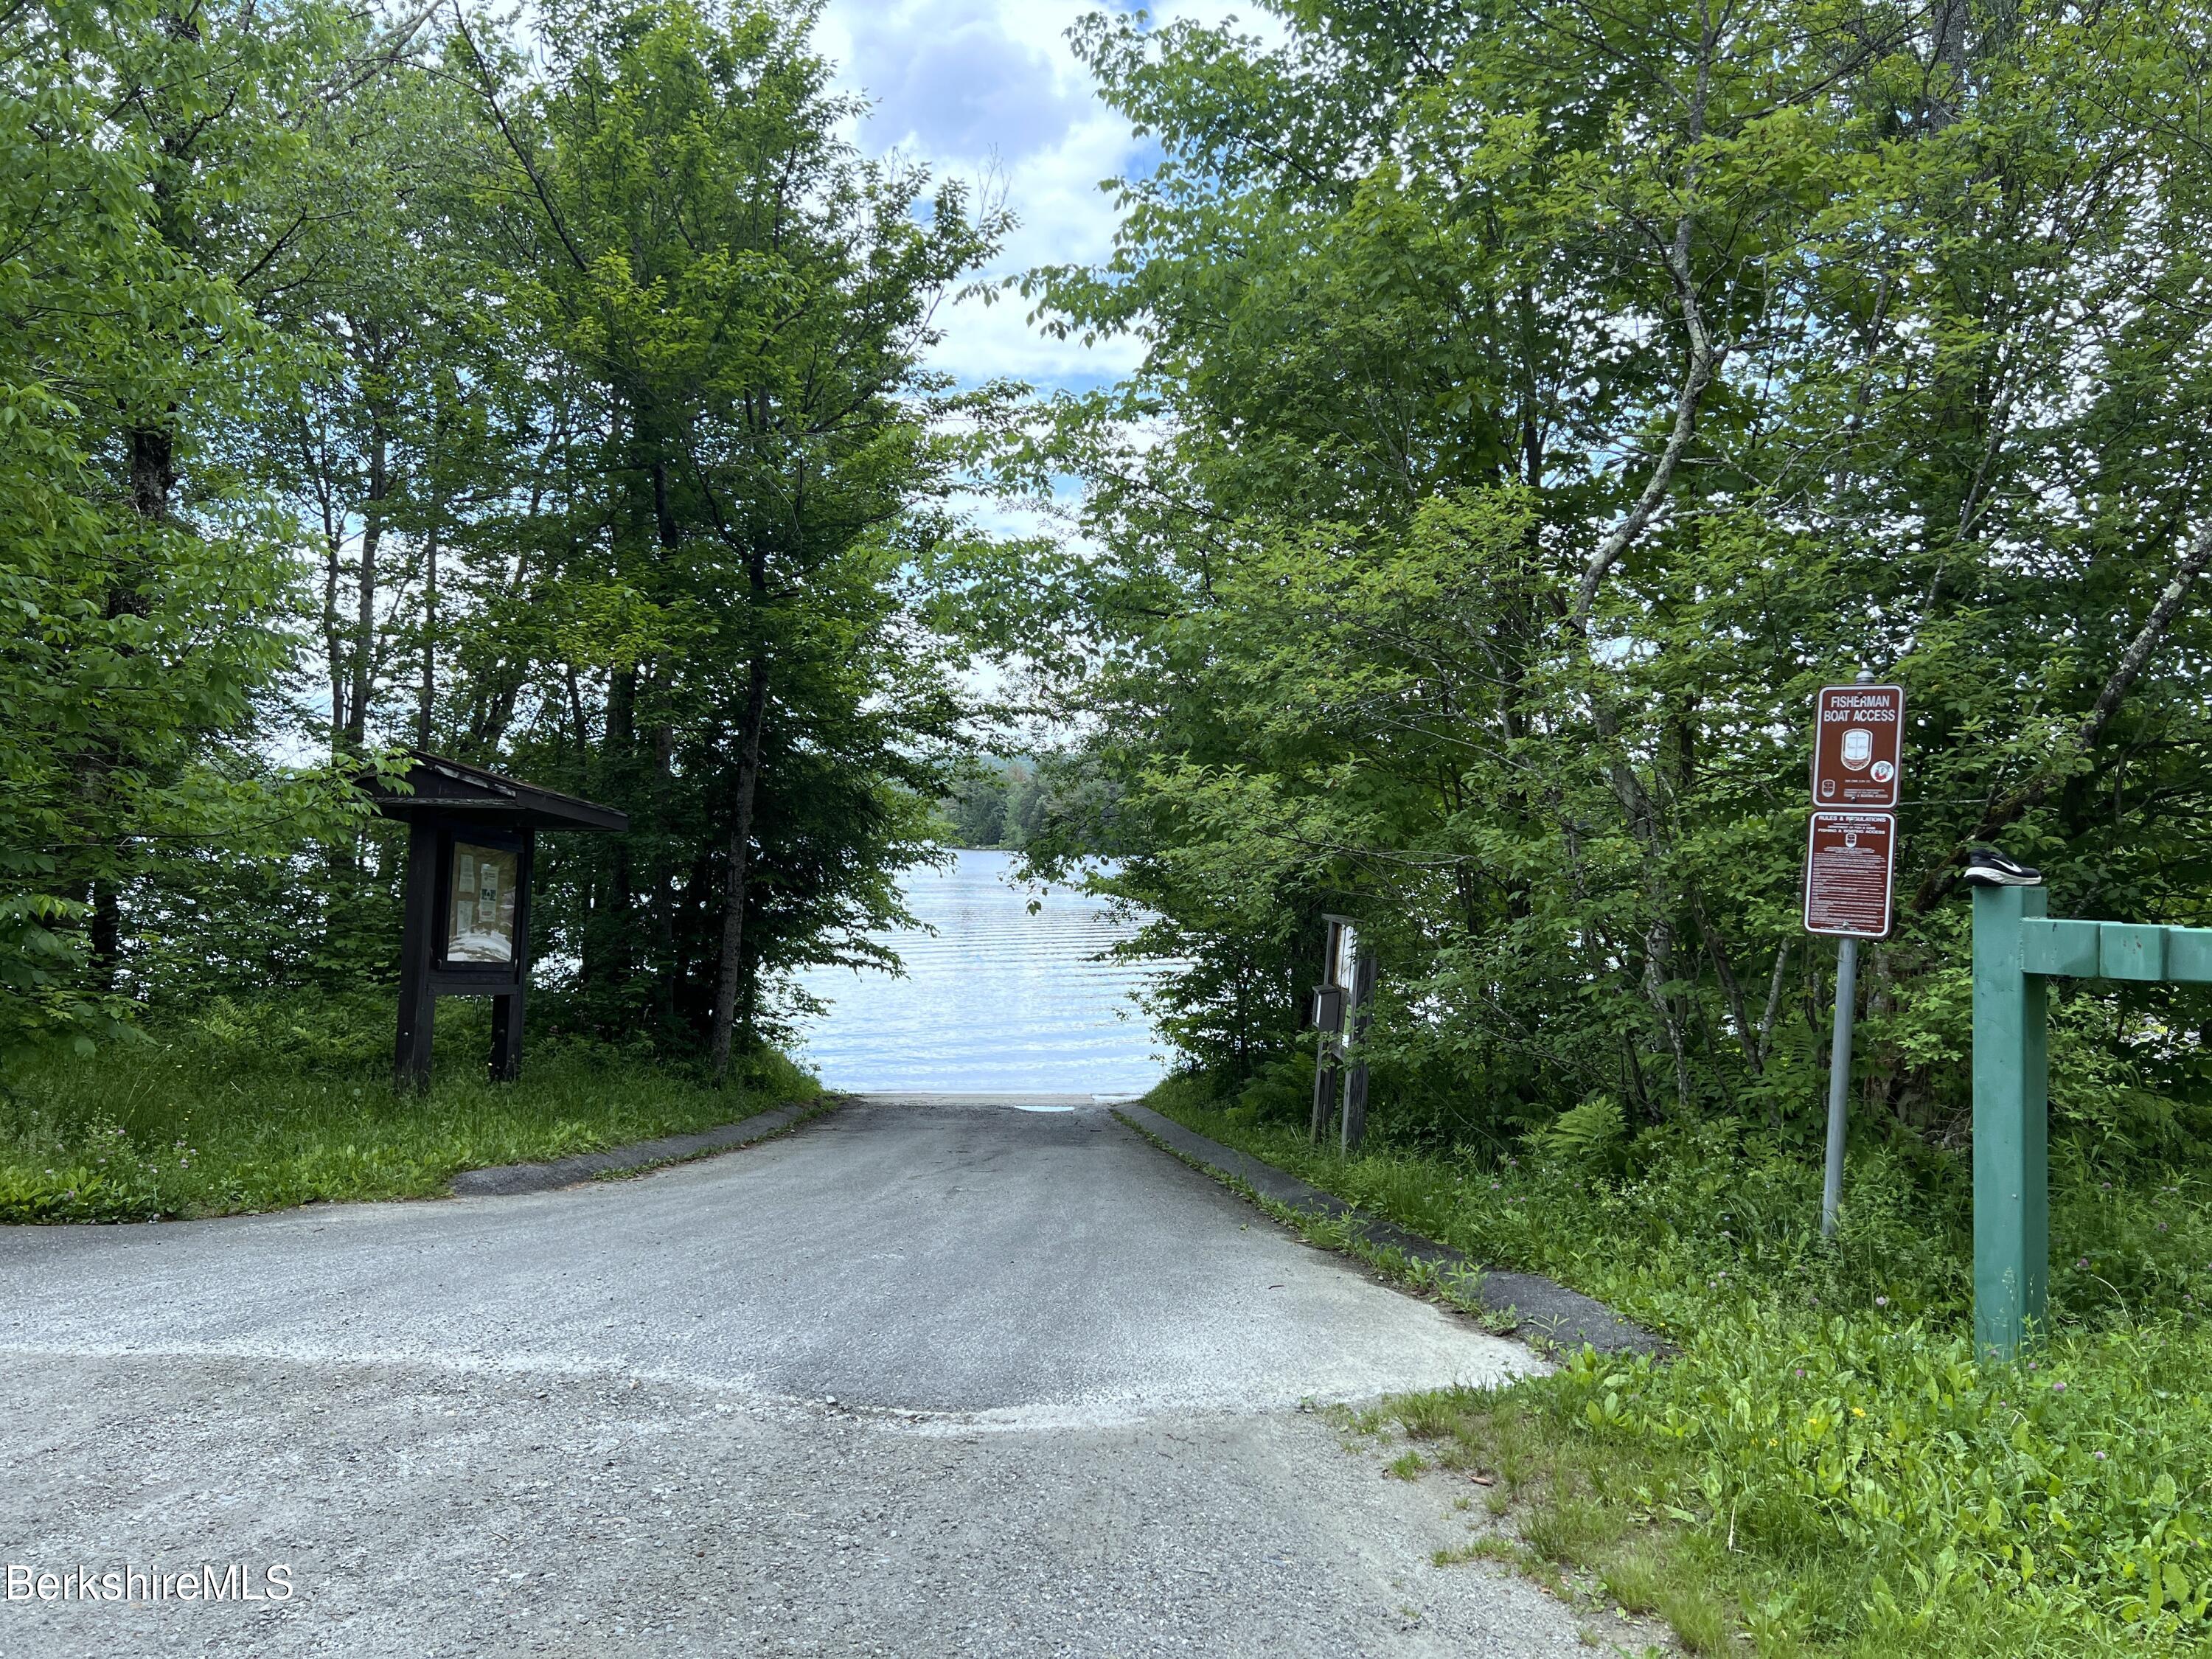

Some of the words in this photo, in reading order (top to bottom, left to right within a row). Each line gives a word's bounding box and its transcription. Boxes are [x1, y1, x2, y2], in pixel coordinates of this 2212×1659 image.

[1831, 695, 1890, 708] FISHERMAN
[1824, 710, 1850, 722] BOAT
[1853, 709, 1895, 722] ACCESS
